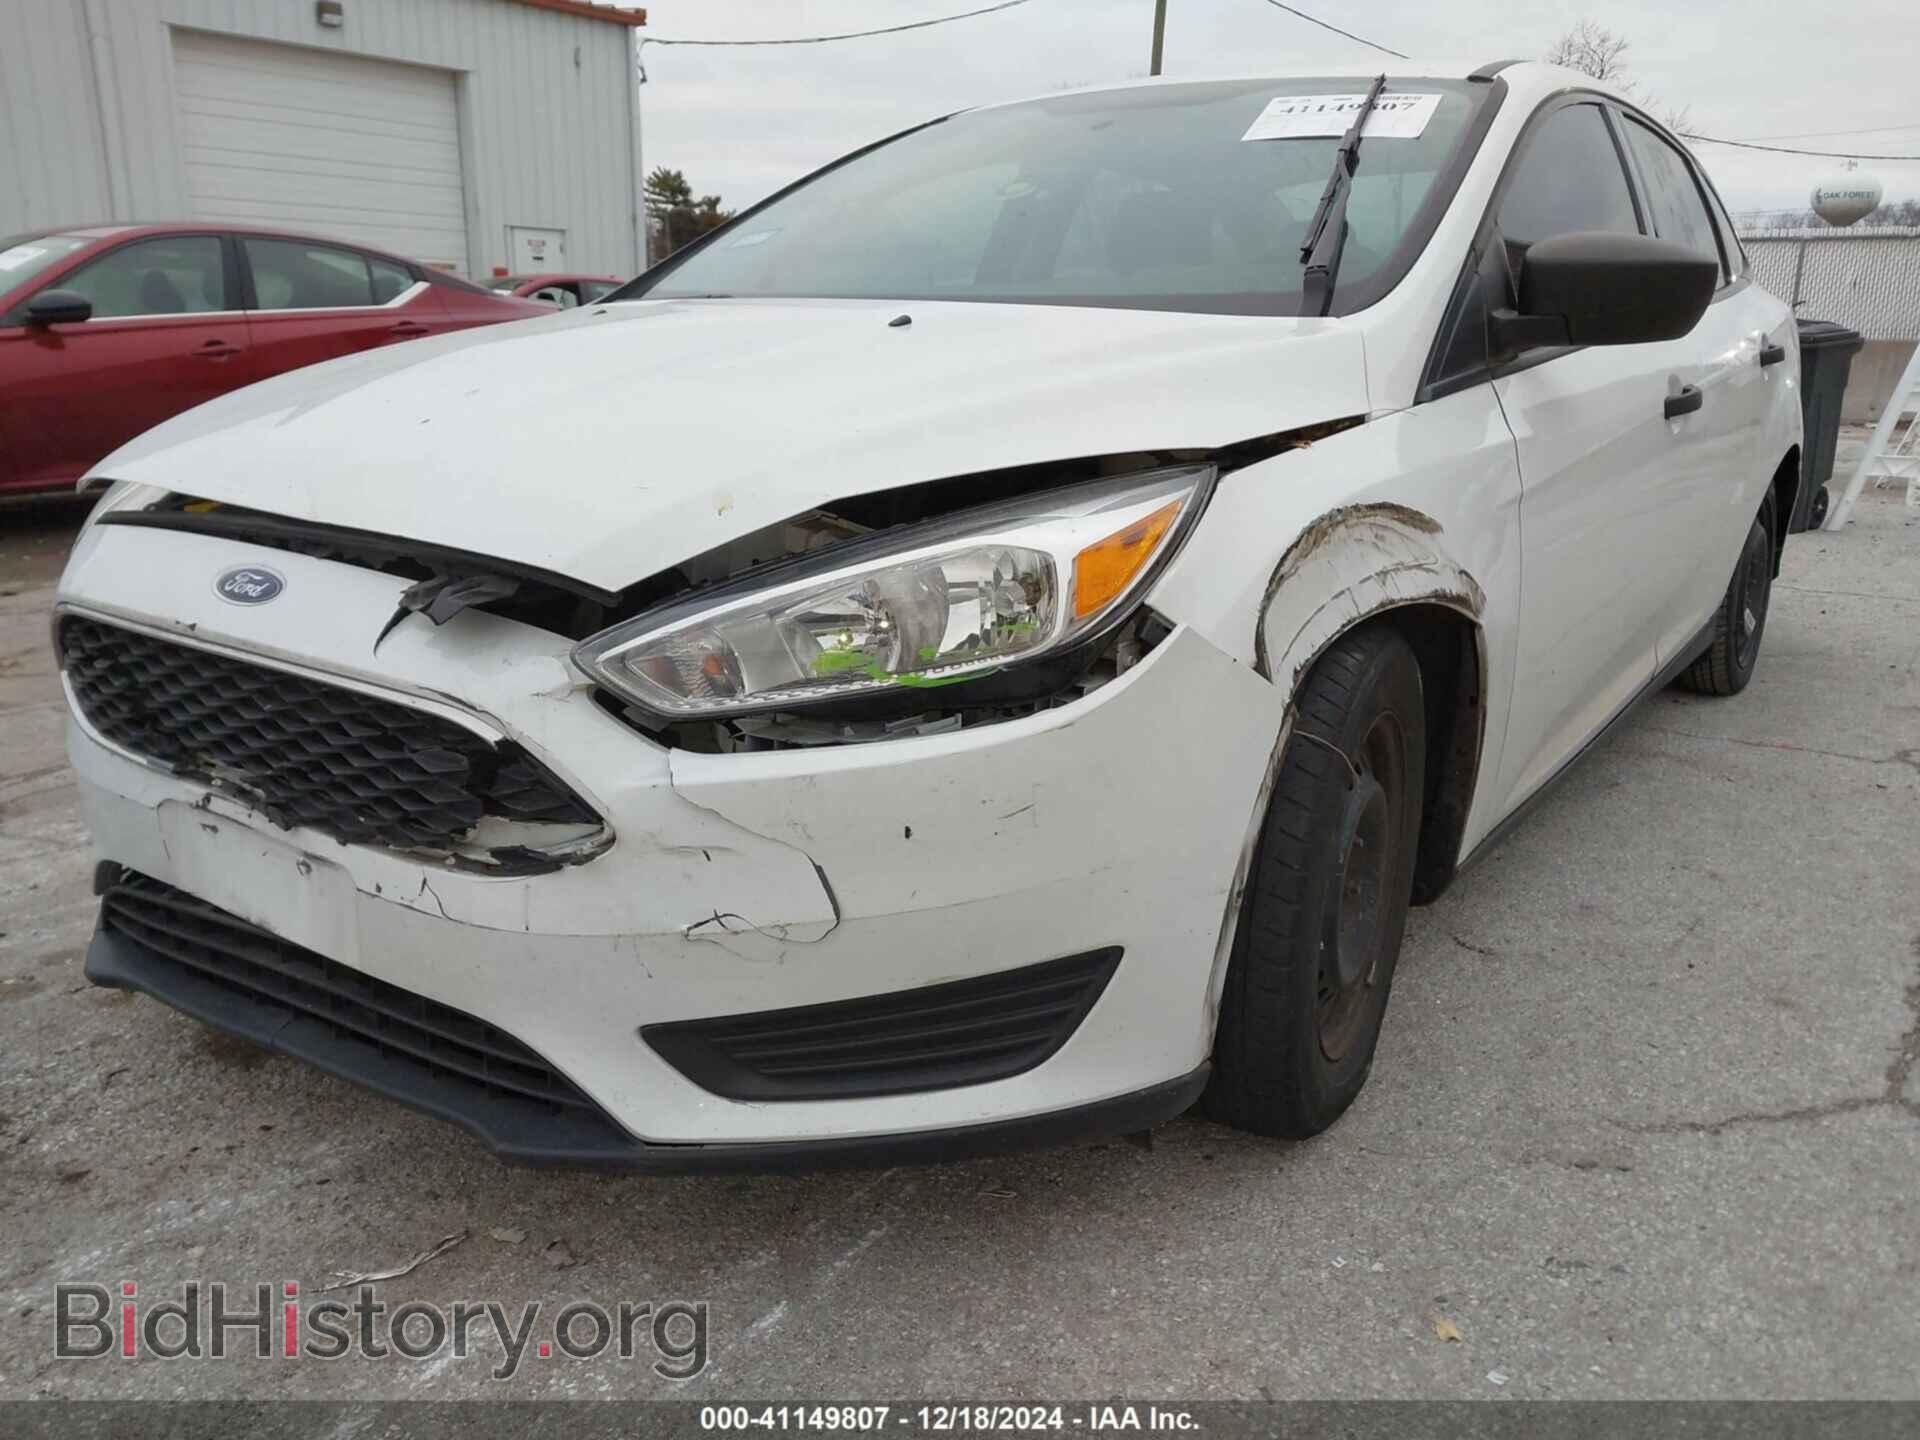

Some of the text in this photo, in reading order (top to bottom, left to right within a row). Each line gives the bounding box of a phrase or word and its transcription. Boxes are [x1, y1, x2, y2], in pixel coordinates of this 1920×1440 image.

[1823, 191, 1875, 200] OAK FOREST
[224, 571, 270, 598] Ford
